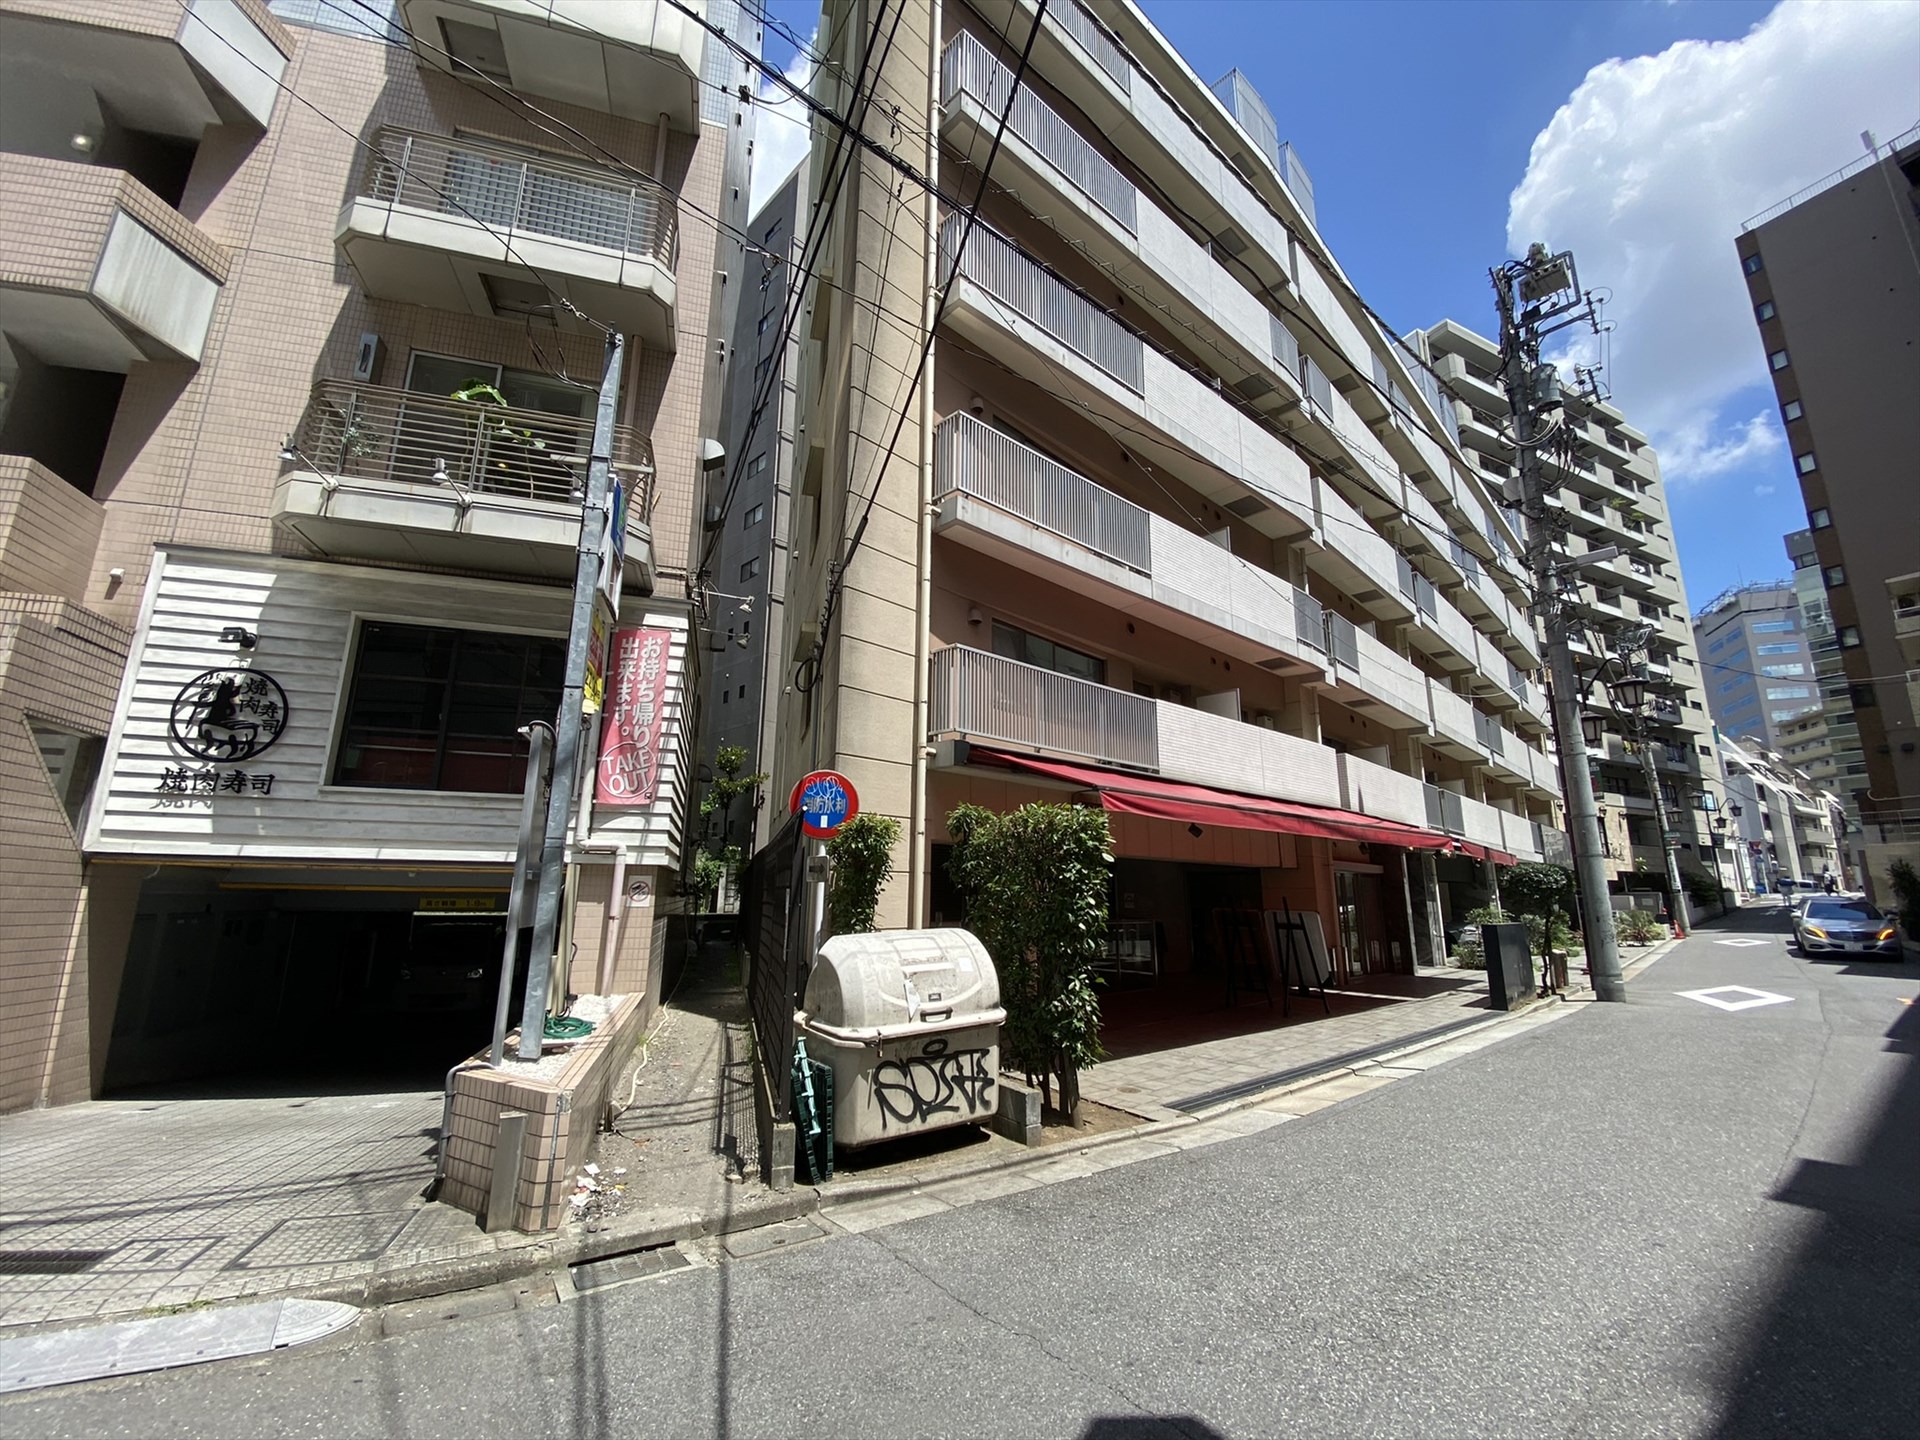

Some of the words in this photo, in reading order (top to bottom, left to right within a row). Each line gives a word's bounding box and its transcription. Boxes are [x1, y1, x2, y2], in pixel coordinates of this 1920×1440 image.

[614, 637, 640, 736] 出来ます。
[633, 636, 662, 748] お持ち帰り
[602, 749, 652, 775] TAKE
[153, 767, 276, 795] 焼肉寿司
[608, 768, 650, 795] OUT
